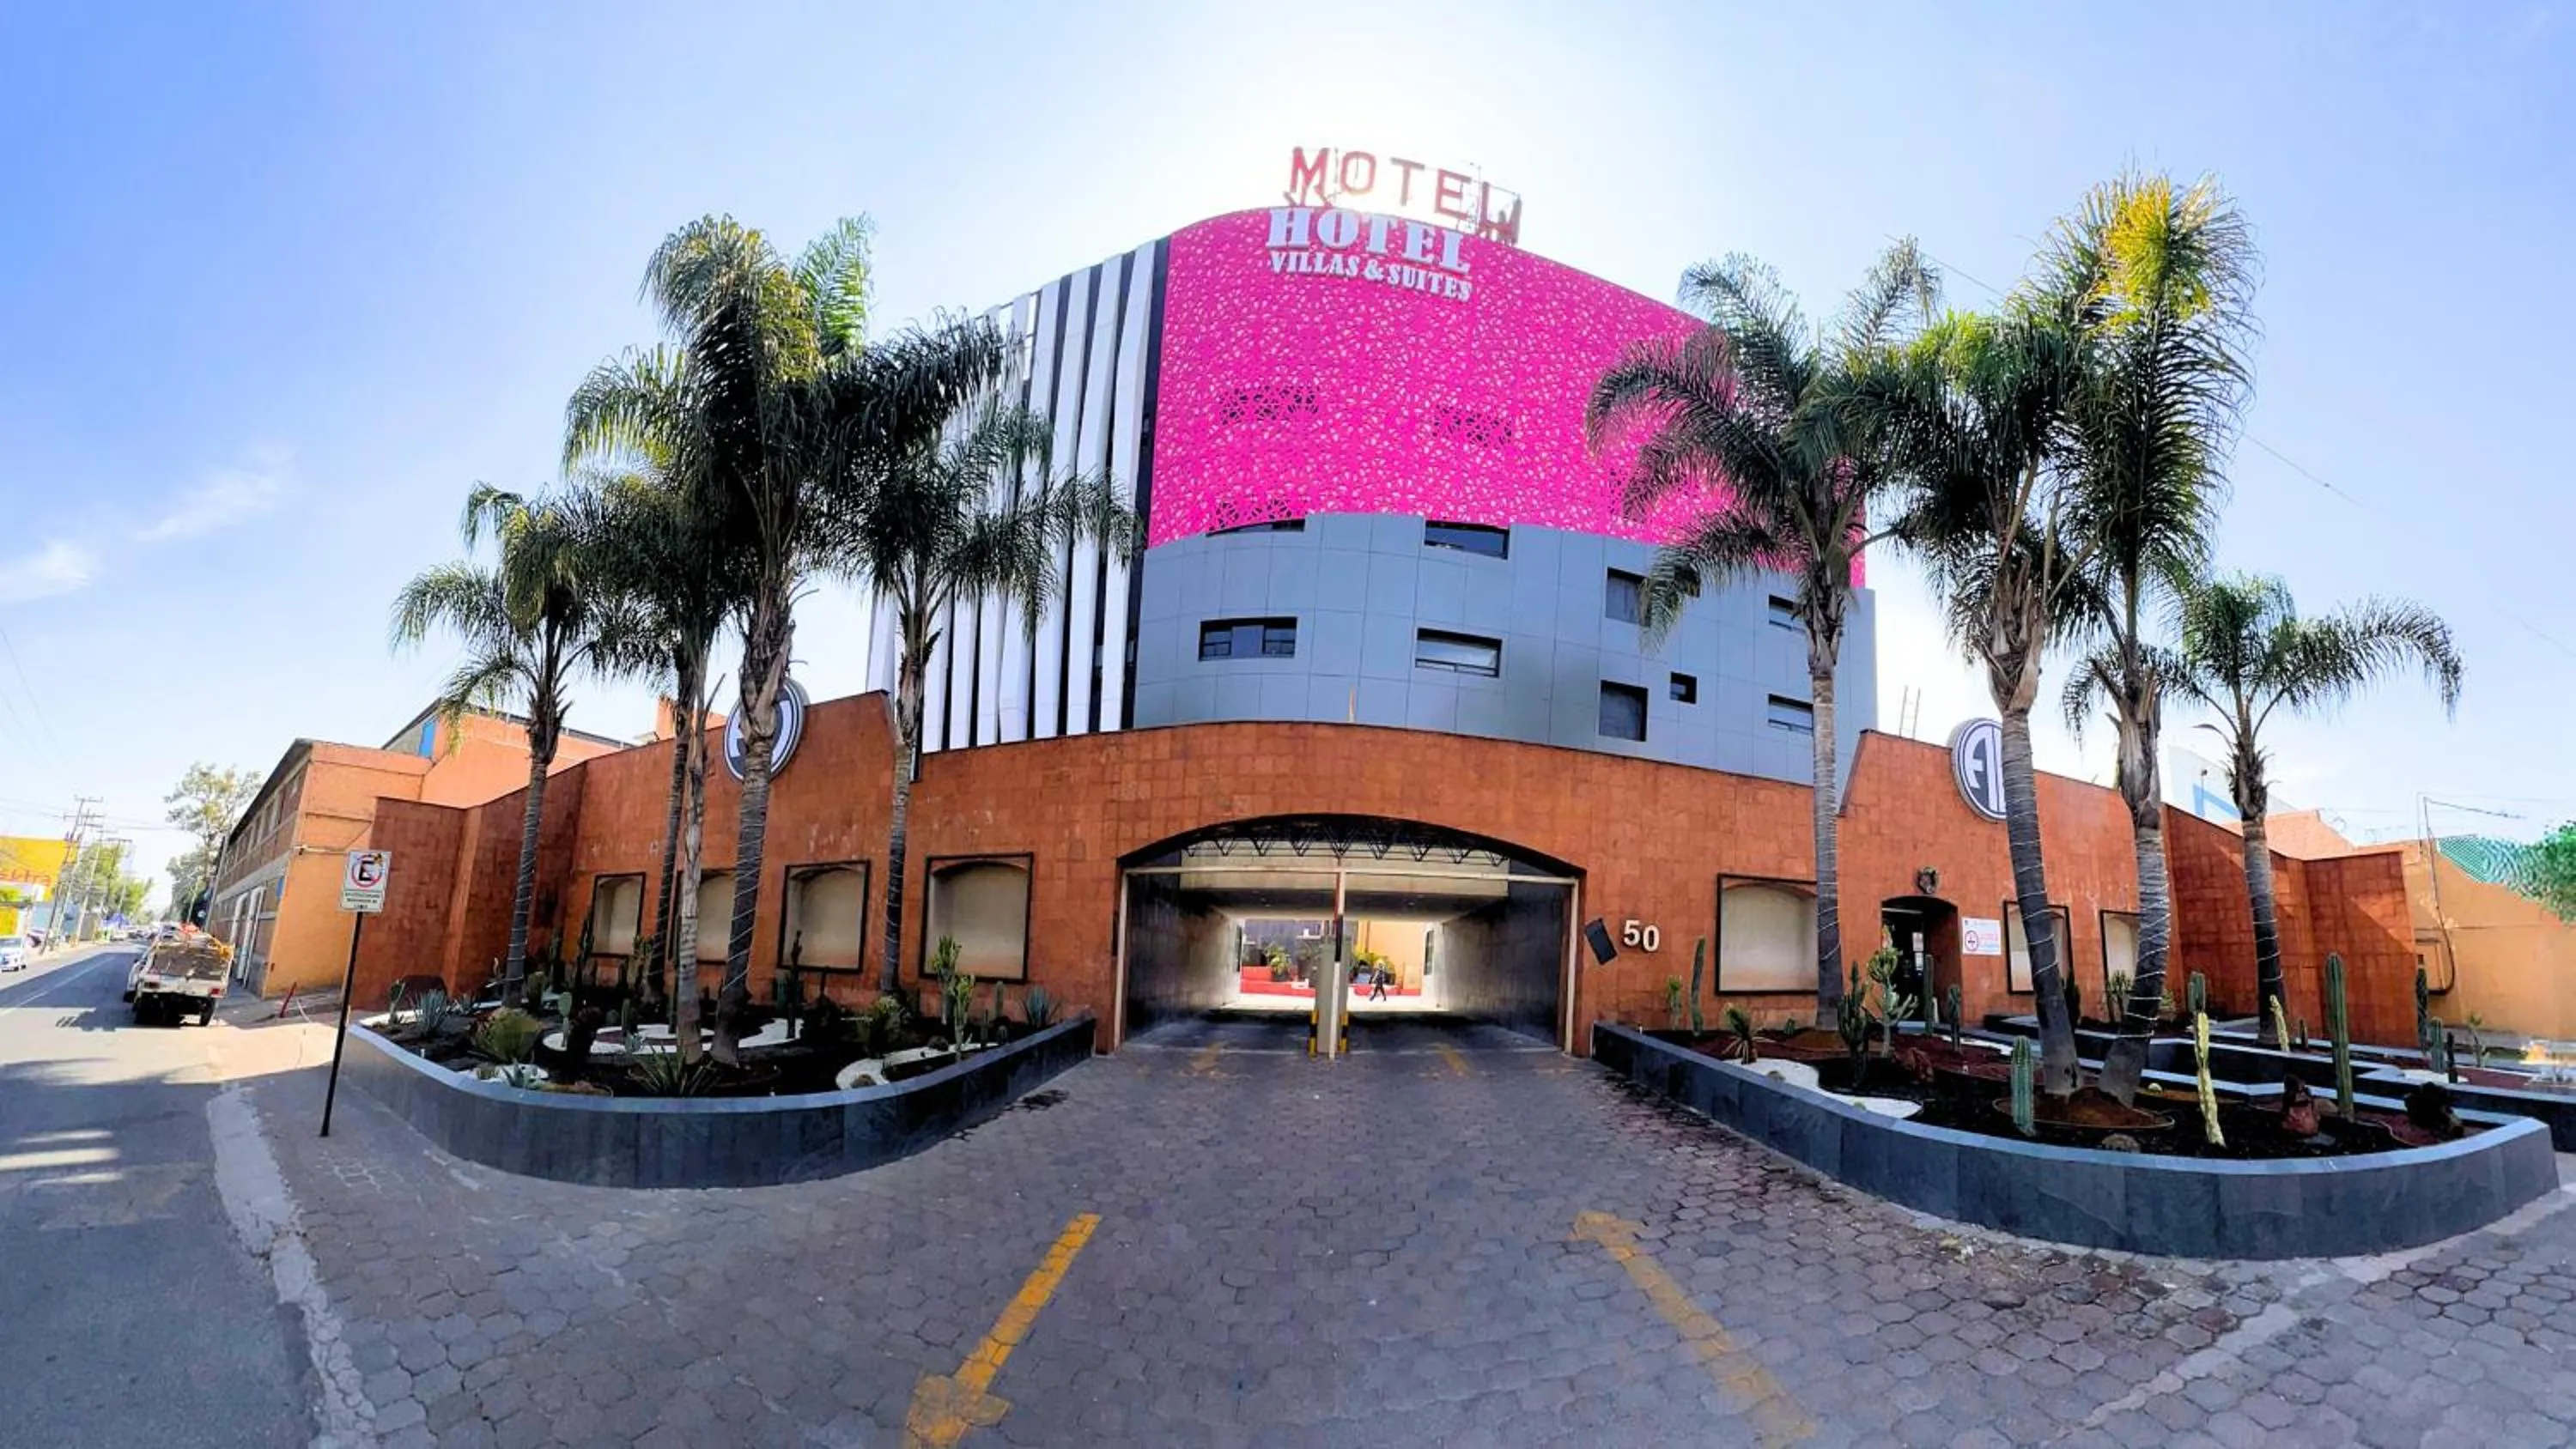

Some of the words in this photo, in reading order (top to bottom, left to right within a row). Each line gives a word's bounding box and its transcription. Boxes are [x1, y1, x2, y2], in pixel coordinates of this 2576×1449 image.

[1291, 147, 1515, 239] MOTEL
[1266, 206, 1471, 275] HOTEL
[1270, 250, 1360, 278] VILLAS
[1364, 258, 1385, 282] &
[1387, 263, 1473, 303] SUITES
[1624, 919, 1660, 952] 50
